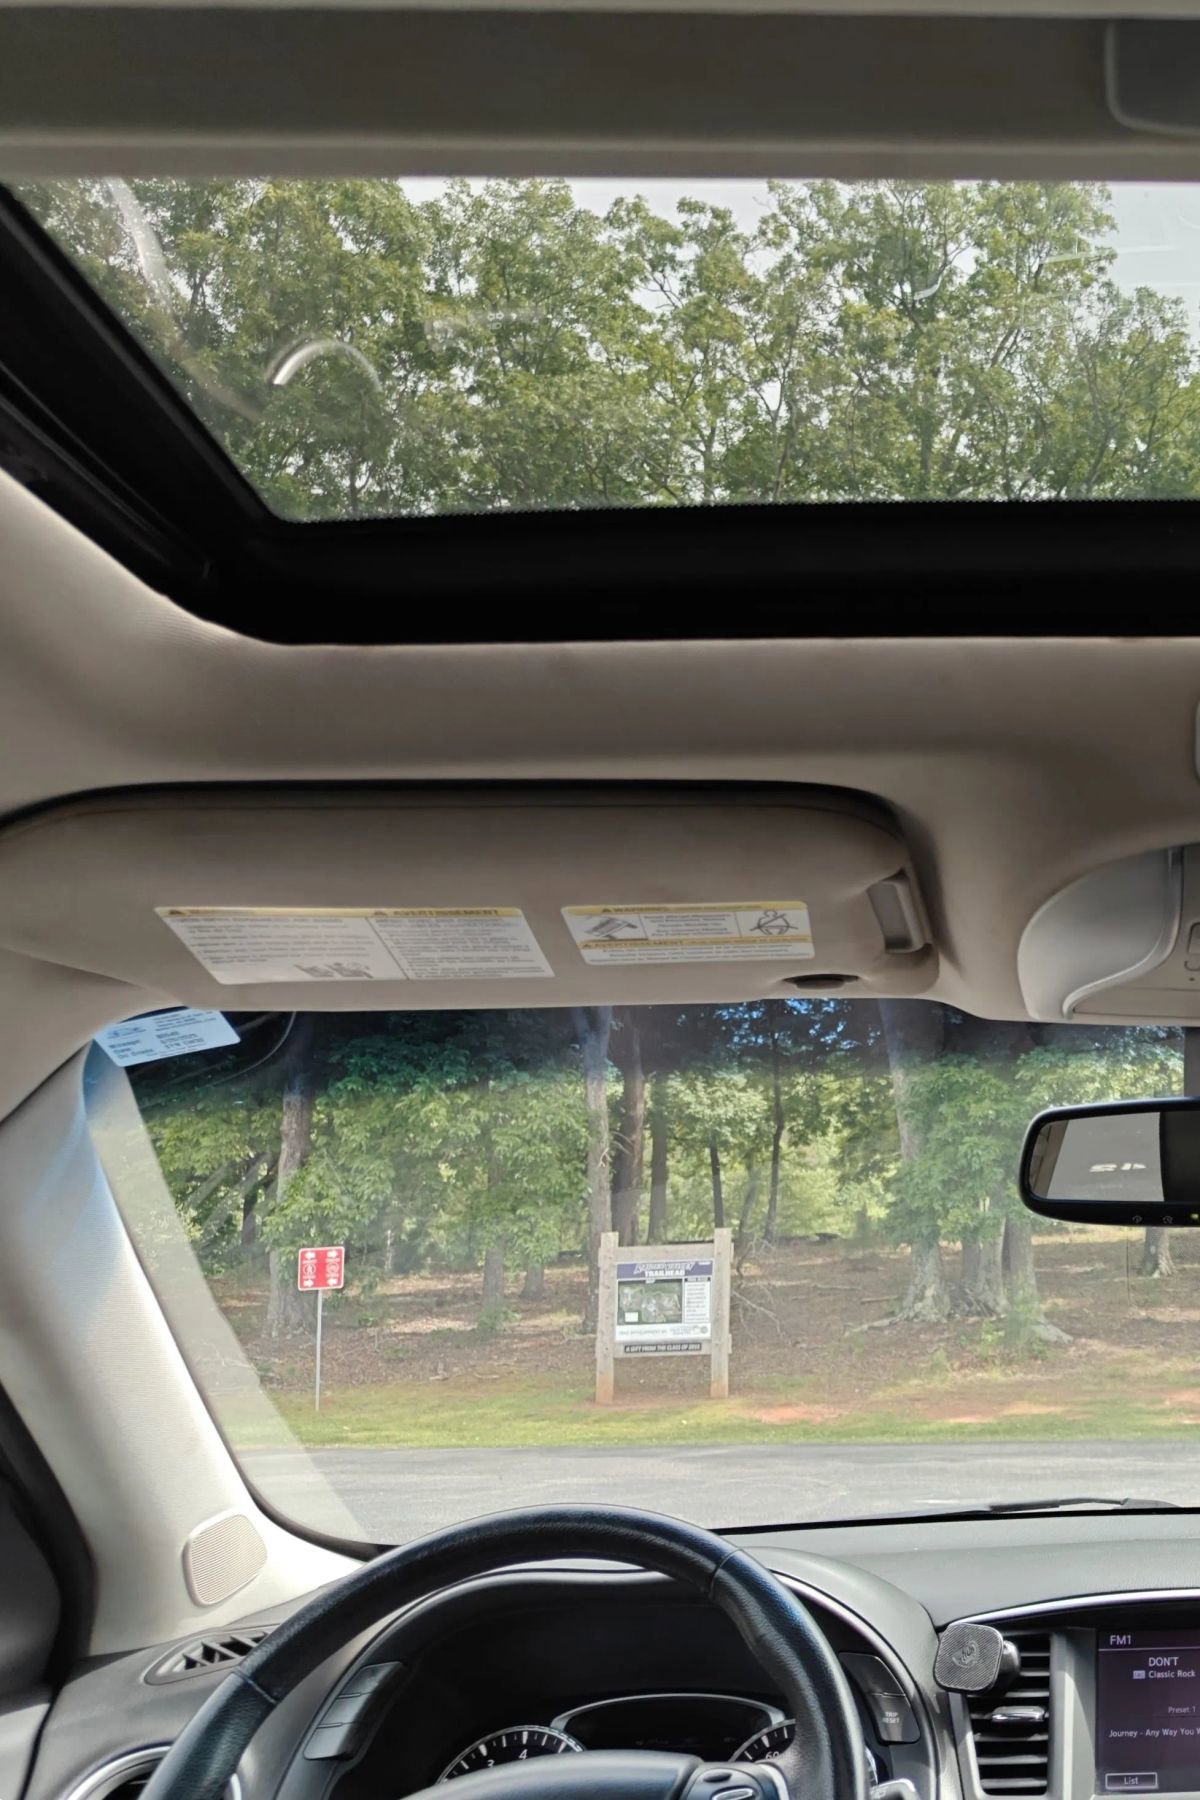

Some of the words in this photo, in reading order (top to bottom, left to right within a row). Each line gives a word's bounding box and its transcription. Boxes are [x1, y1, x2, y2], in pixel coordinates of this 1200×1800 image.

[644, 1269, 686, 1277] TRAILHEAD
[1109, 1634, 1132, 1646] FM1
[1148, 1656, 1179, 1667] DON'T
[1148, 1670, 1175, 1679] Classic
[1177, 1669, 1196, 1678] Rock
[1168, 1706, 1190, 1714] Preset
[1108, 1729, 1138, 1739] Journey
[1145, 1728, 1160, 1738] Any
[1162, 1728, 1178, 1738] Way
[1180, 1727, 1195, 1736] You
[519, 1748, 529, 1760] 4
[1123, 1776, 1139, 1786] List
